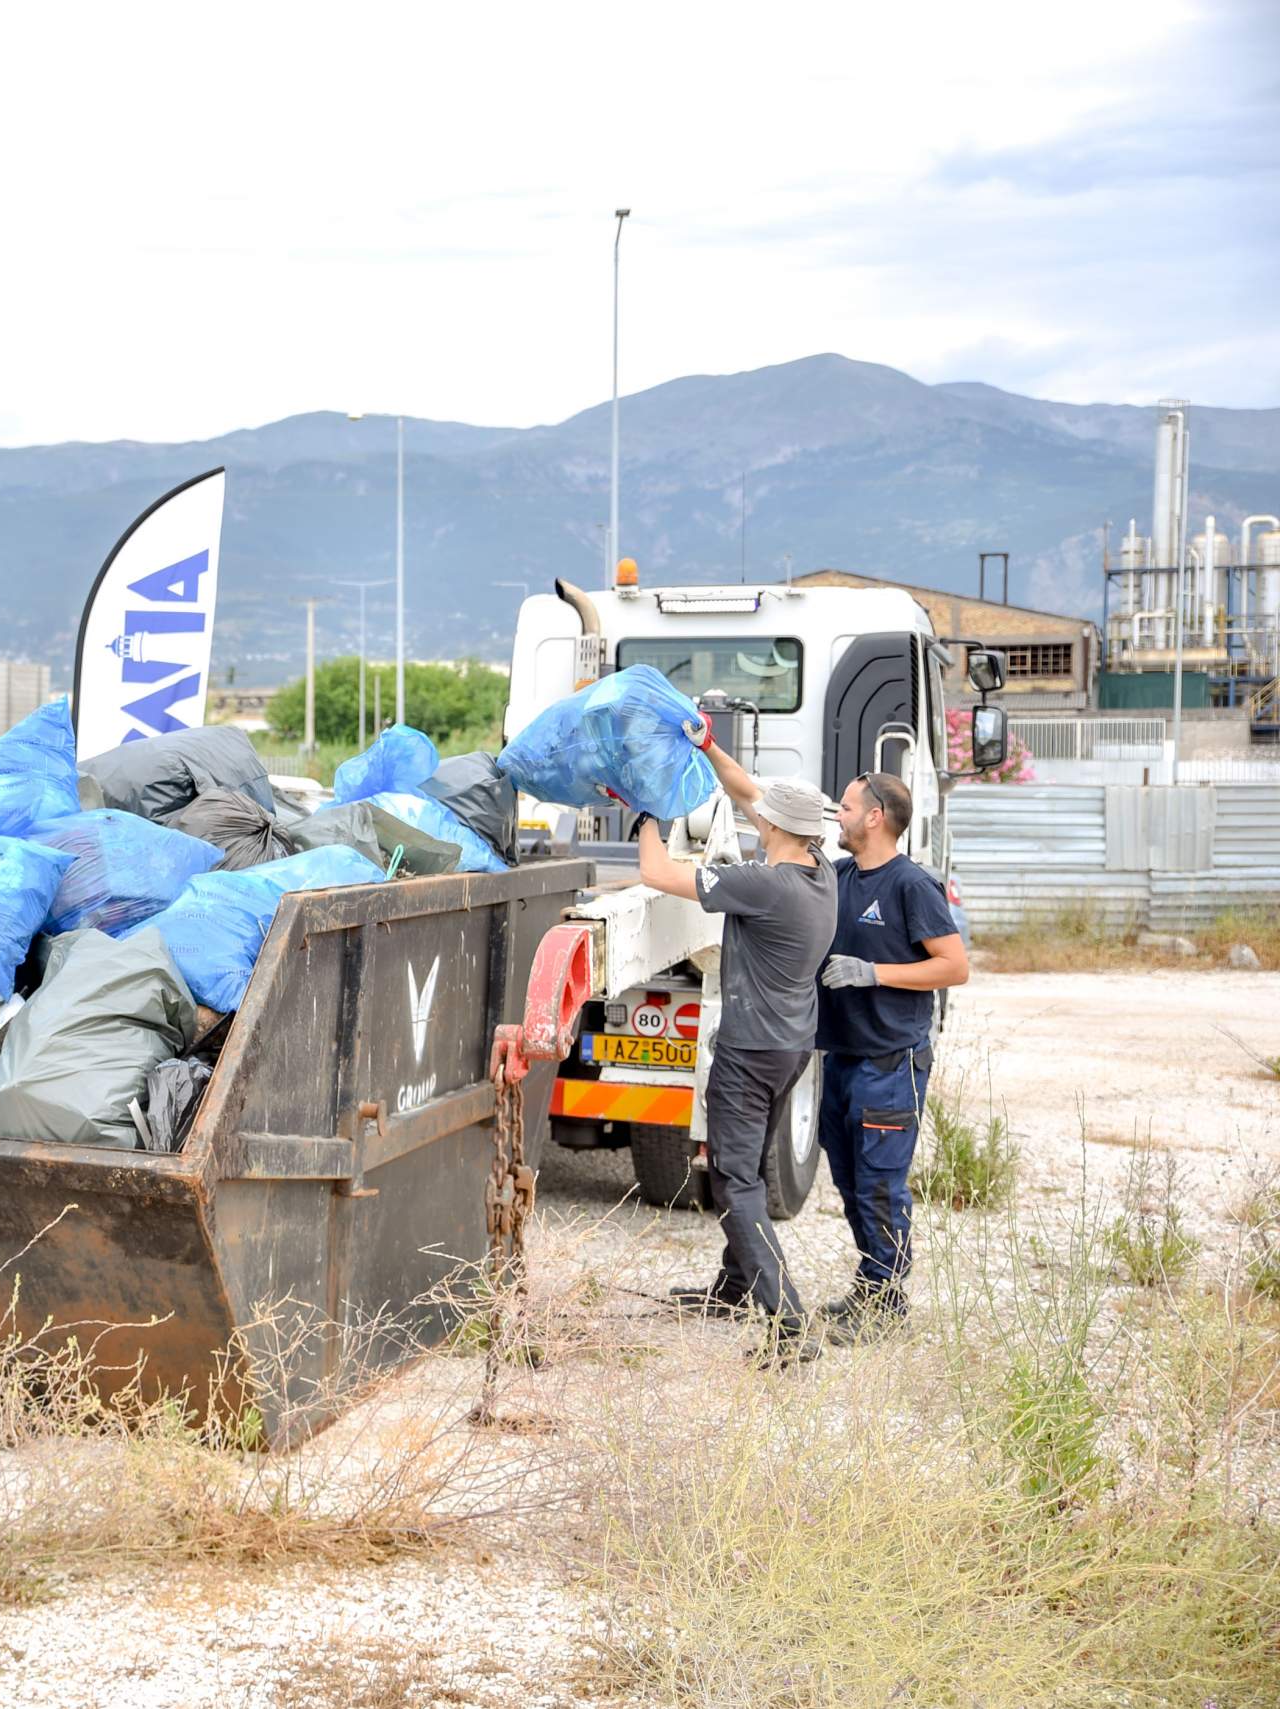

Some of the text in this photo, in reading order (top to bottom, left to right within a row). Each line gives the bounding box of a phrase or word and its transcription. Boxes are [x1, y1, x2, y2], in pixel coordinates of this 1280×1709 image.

[639, 1014, 661, 1028] 80
[604, 1039, 698, 1064] IAZ 500
[397, 1072, 437, 1112] GROUP
